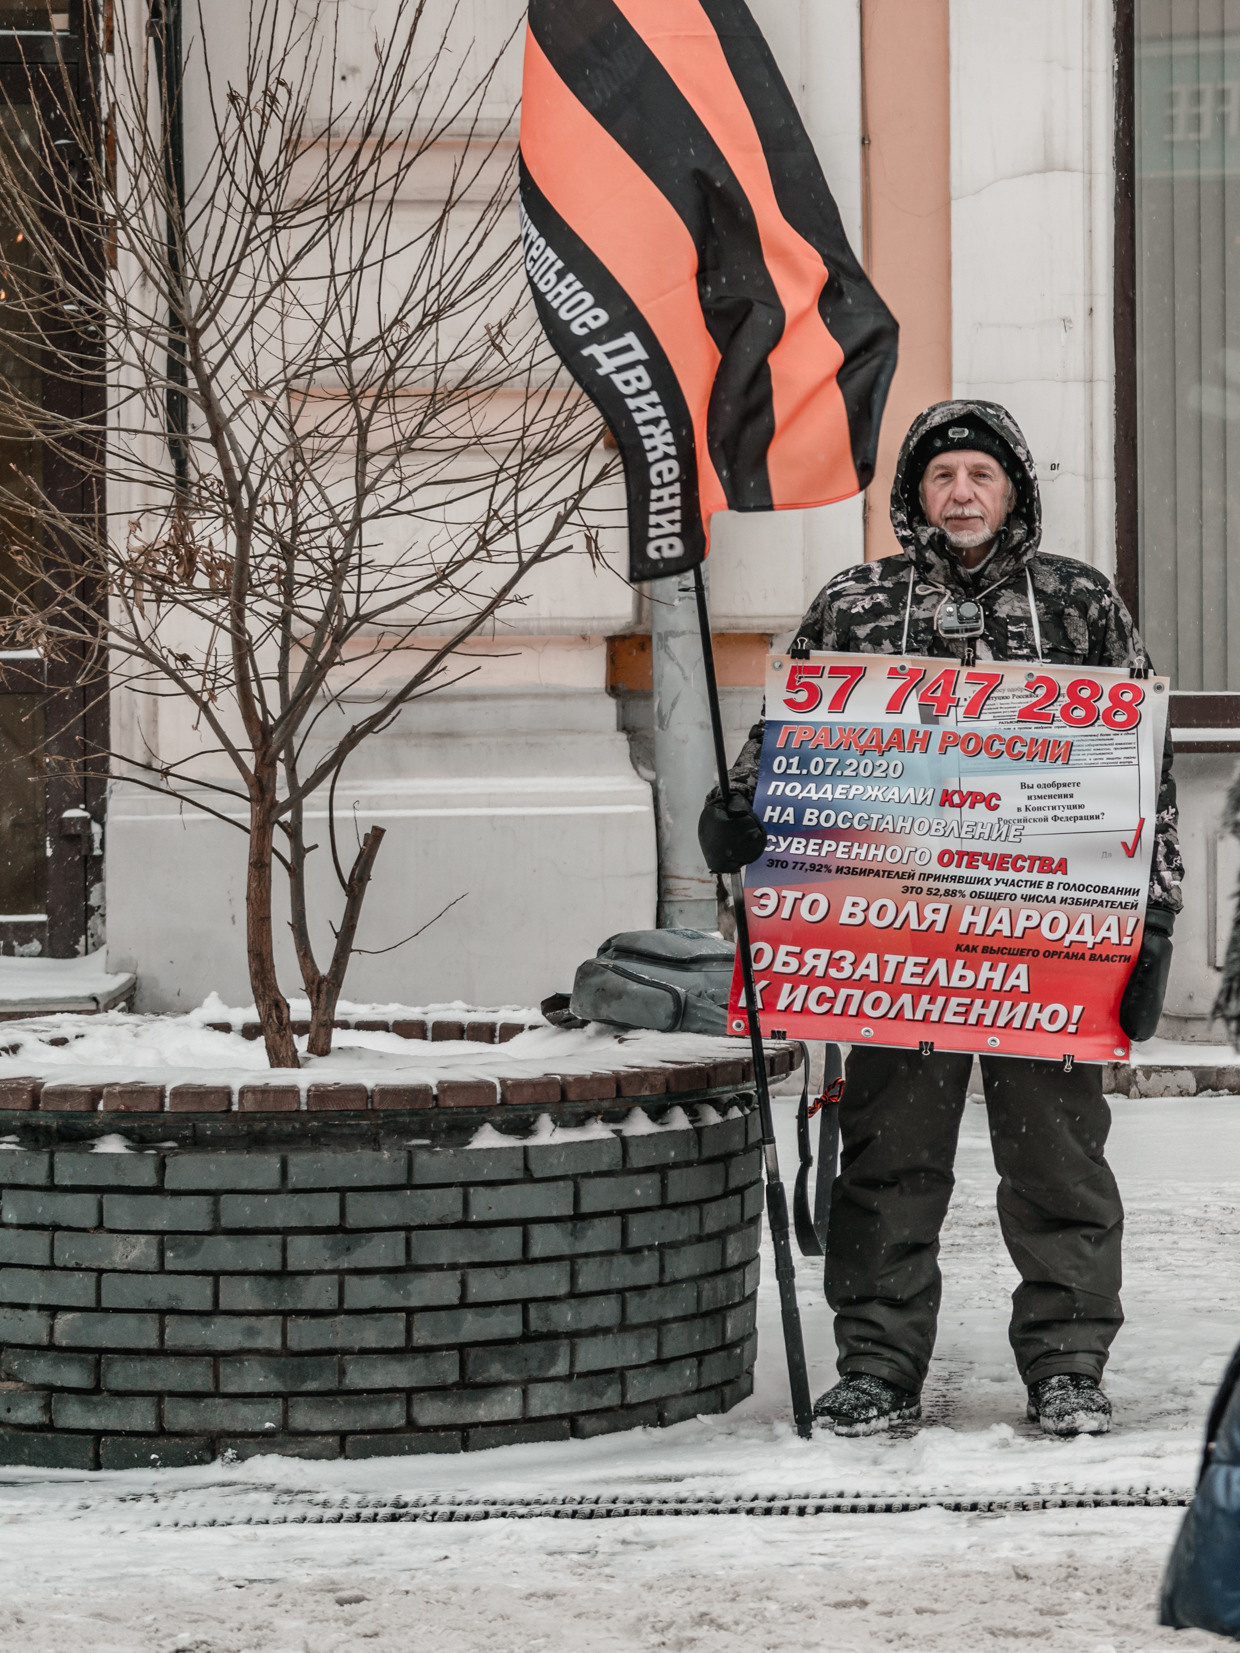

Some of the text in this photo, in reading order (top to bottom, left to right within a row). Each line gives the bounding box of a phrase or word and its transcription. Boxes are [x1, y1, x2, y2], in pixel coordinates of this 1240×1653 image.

[580, 331, 685, 560] Движение
[783, 664, 1144, 731] 57 747 288
[776, 725, 1073, 764] ГРАЖДАН РОССИИ
[772, 755, 904, 778] 01.07.2020
[1020, 780, 1081, 790] Вы одобряете
[766, 781, 1002, 811] ПОДДЕРЖАЛИ КУРС
[1024, 803, 1085, 813] Конституцию
[1027, 793, 1074, 801] изменения
[763, 805, 1024, 843] НА ВОССТАНОВЛЕНИЕ
[997, 812, 1105, 825] Российской Федерации?
[764, 834, 1068, 875] СУВЕРЕННОГО ОТЕЧЕСТВА
[766, 858, 1140, 897] ЭТО 77,92% ИЗБИРАТЕЛЕЙ ПРИНЯВШИХ УЧАСТИЕ В ГОЛОСОВАНИИ
[901, 885, 1139, 911] ЭТО 52,88% ОБЩЕГО ЧИСЛА ИЗБИРАТЕЛЕЙ
[750, 886, 1140, 950] ЭТО ВОЛЯ НАРОДА!
[750, 941, 1030, 993] ОБЯЗАТЕЛЬНА
[955, 943, 1131, 964] КАК ВЫСШЕГО ОРГАНА ВЛАСТИ
[738, 980, 771, 1011] К
[776, 983, 1084, 1034] ИСПОЛНЕНИЮ!
